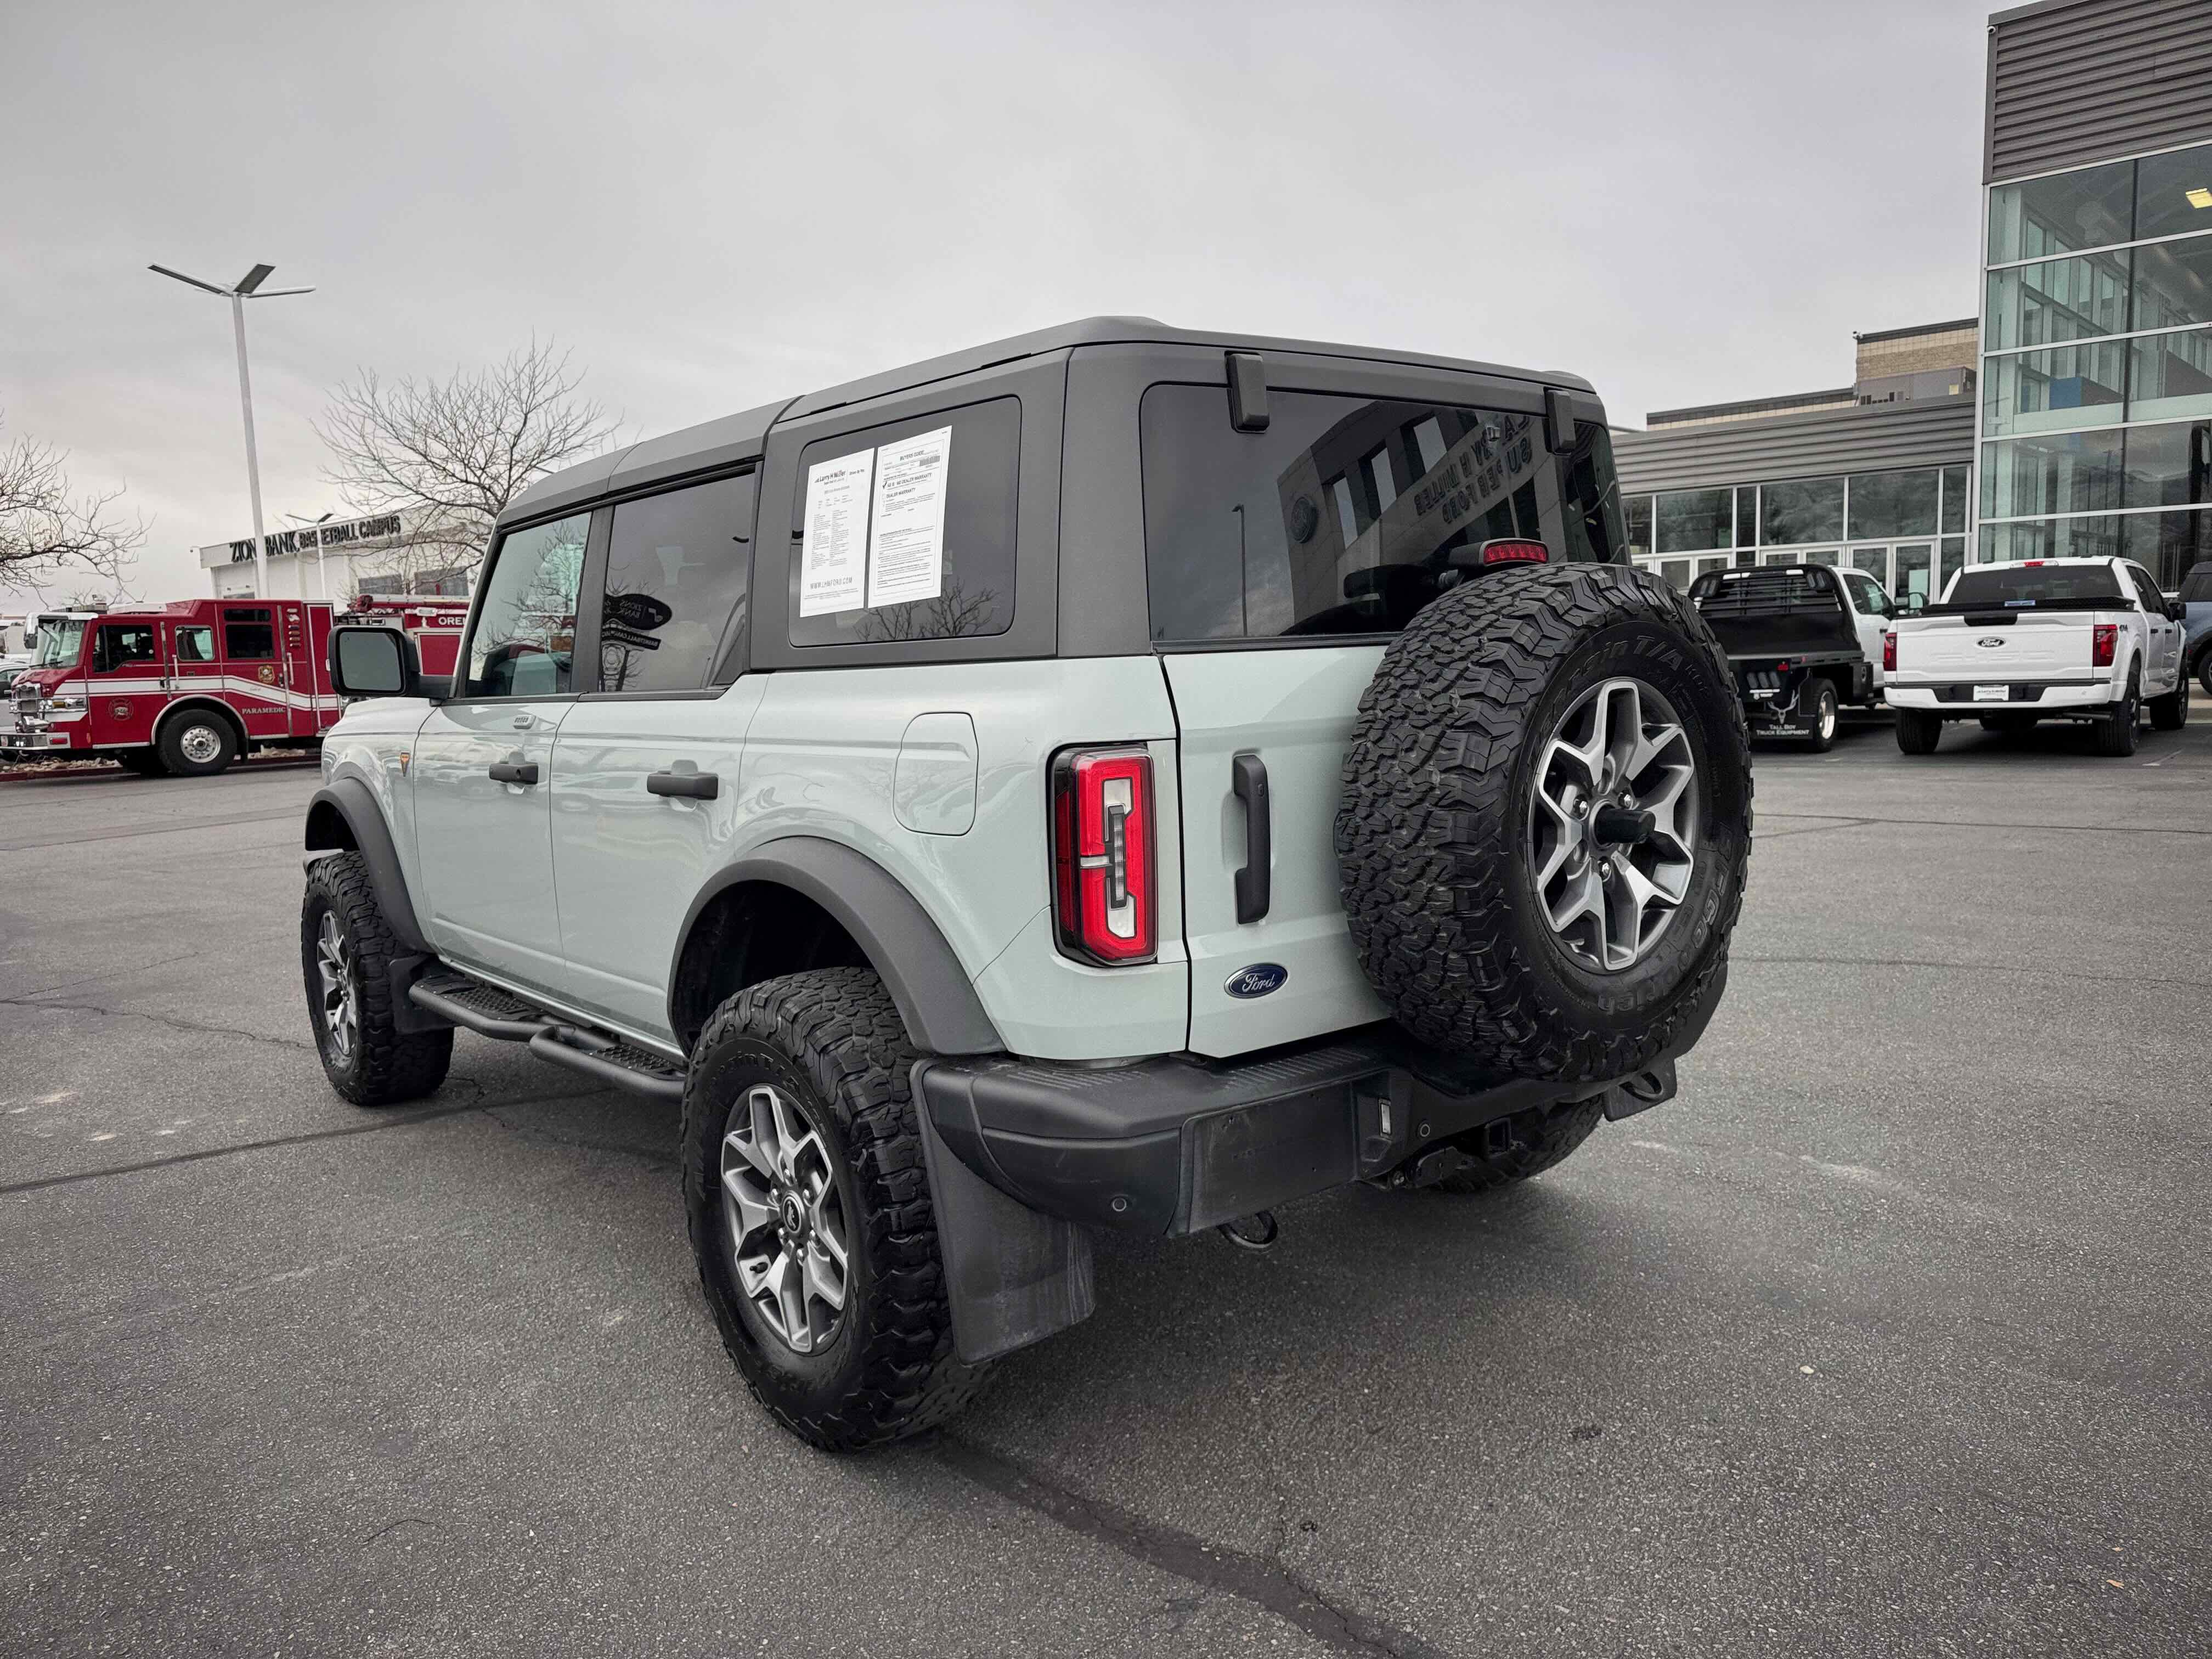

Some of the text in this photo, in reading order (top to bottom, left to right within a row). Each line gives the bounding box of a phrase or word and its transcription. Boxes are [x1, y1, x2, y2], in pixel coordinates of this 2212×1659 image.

[358, 515, 401, 539] CAMPUS
[242, 706, 286, 714] PARAMEDIC
[1242, 973, 1276, 992] Ford
